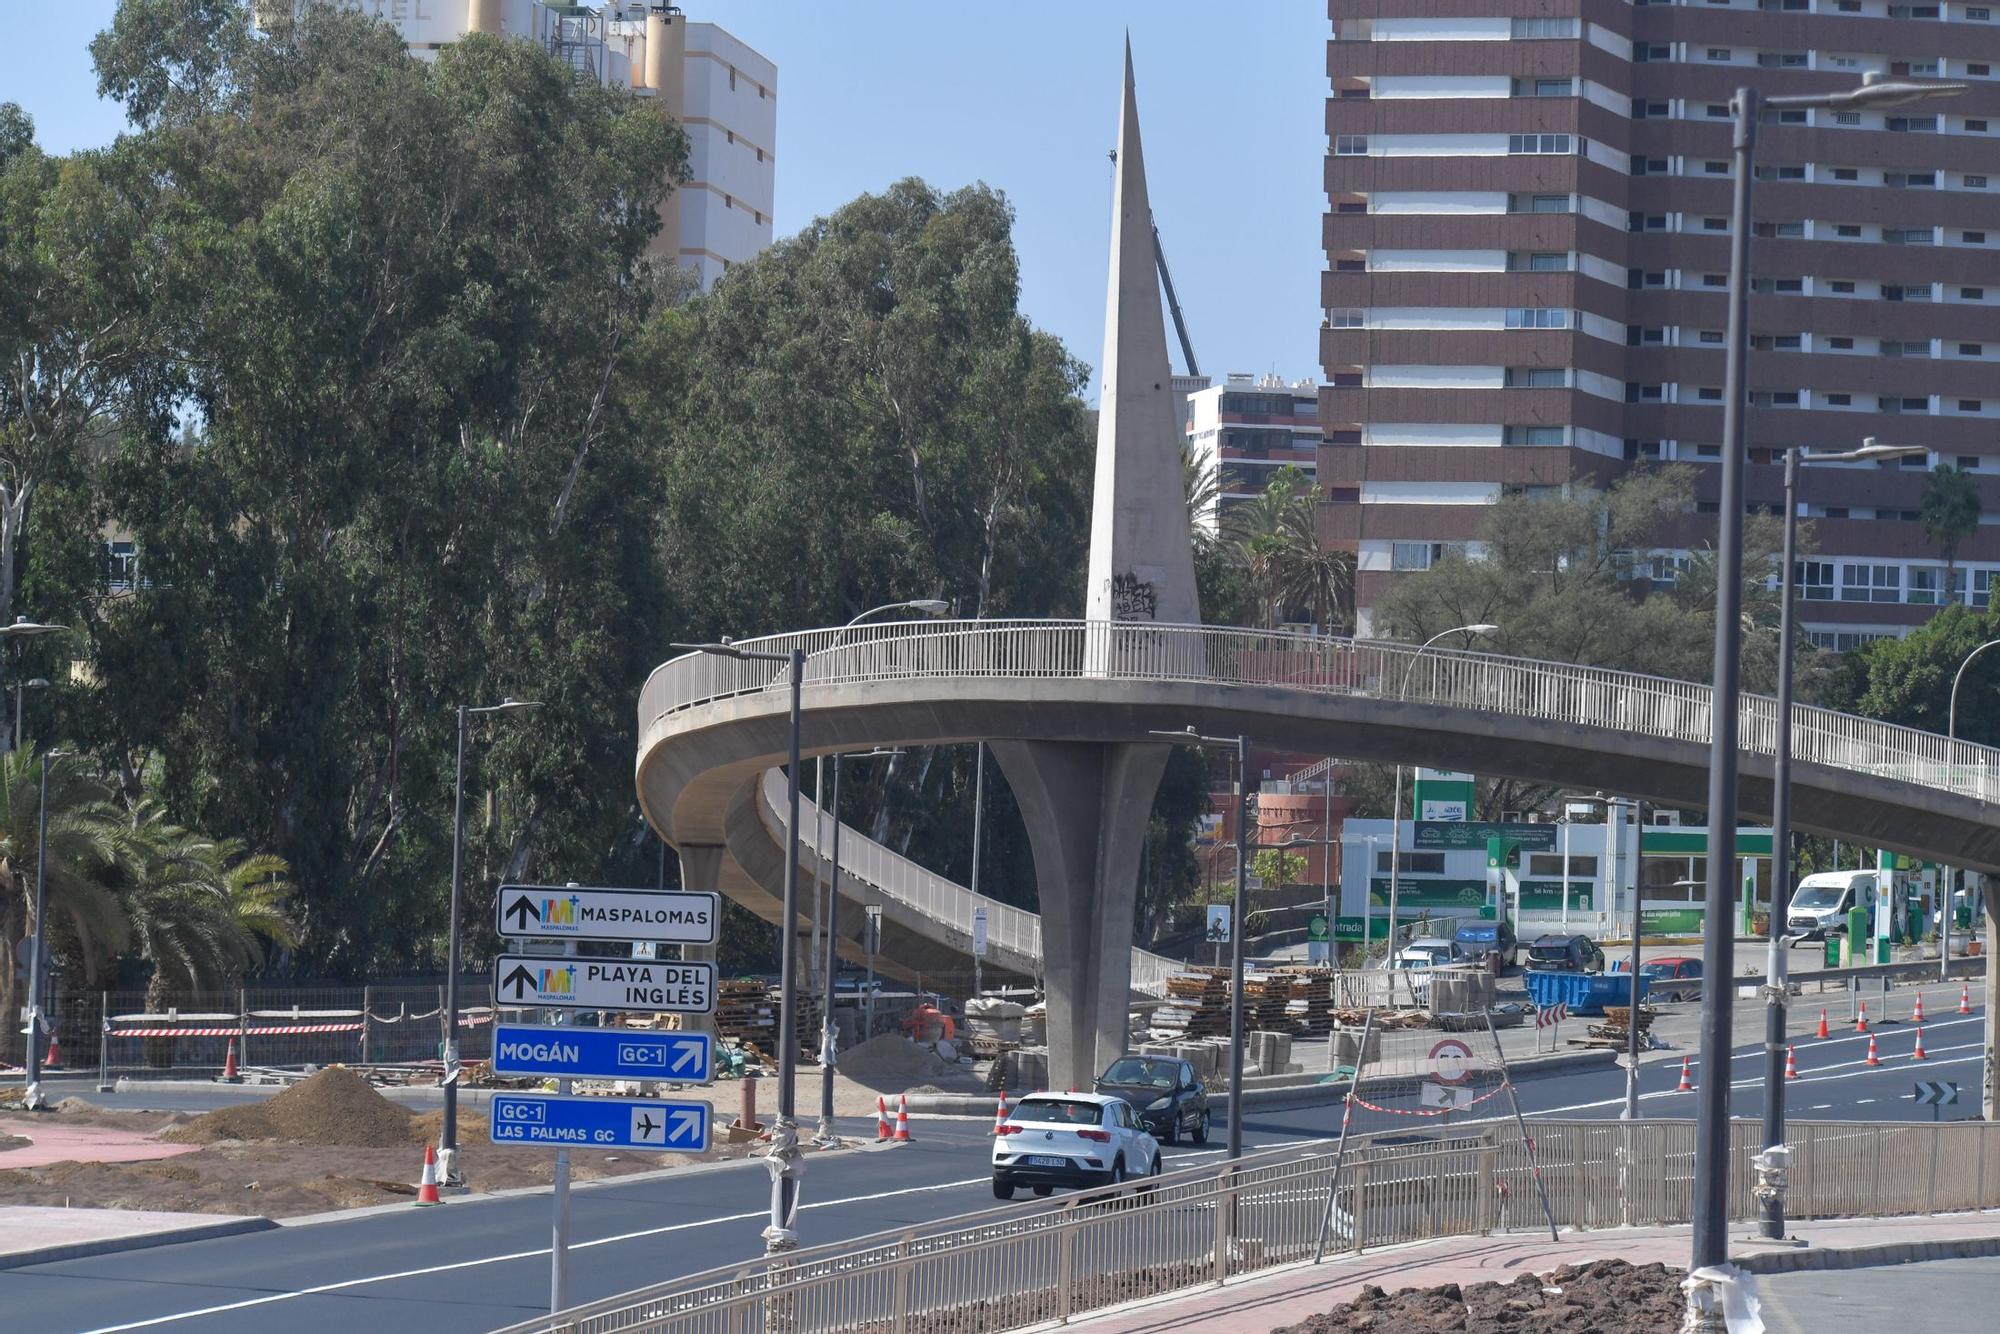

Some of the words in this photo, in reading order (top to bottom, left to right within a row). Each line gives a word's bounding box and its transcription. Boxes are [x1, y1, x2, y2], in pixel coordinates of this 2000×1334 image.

[581, 908, 708, 925] MASPALOMAS
[588, 965, 653, 984] PLAYA
[666, 969, 705, 985] DEL
[626, 986, 705, 1005] INGLÉS
[500, 1042, 578, 1063] MOGÁN
[622, 1047, 663, 1062] GC-1
[502, 1104, 543, 1119] GC-1
[497, 1125, 524, 1138] LAS
[530, 1127, 587, 1141] PALMAS
[594, 1130, 615, 1142] GC
